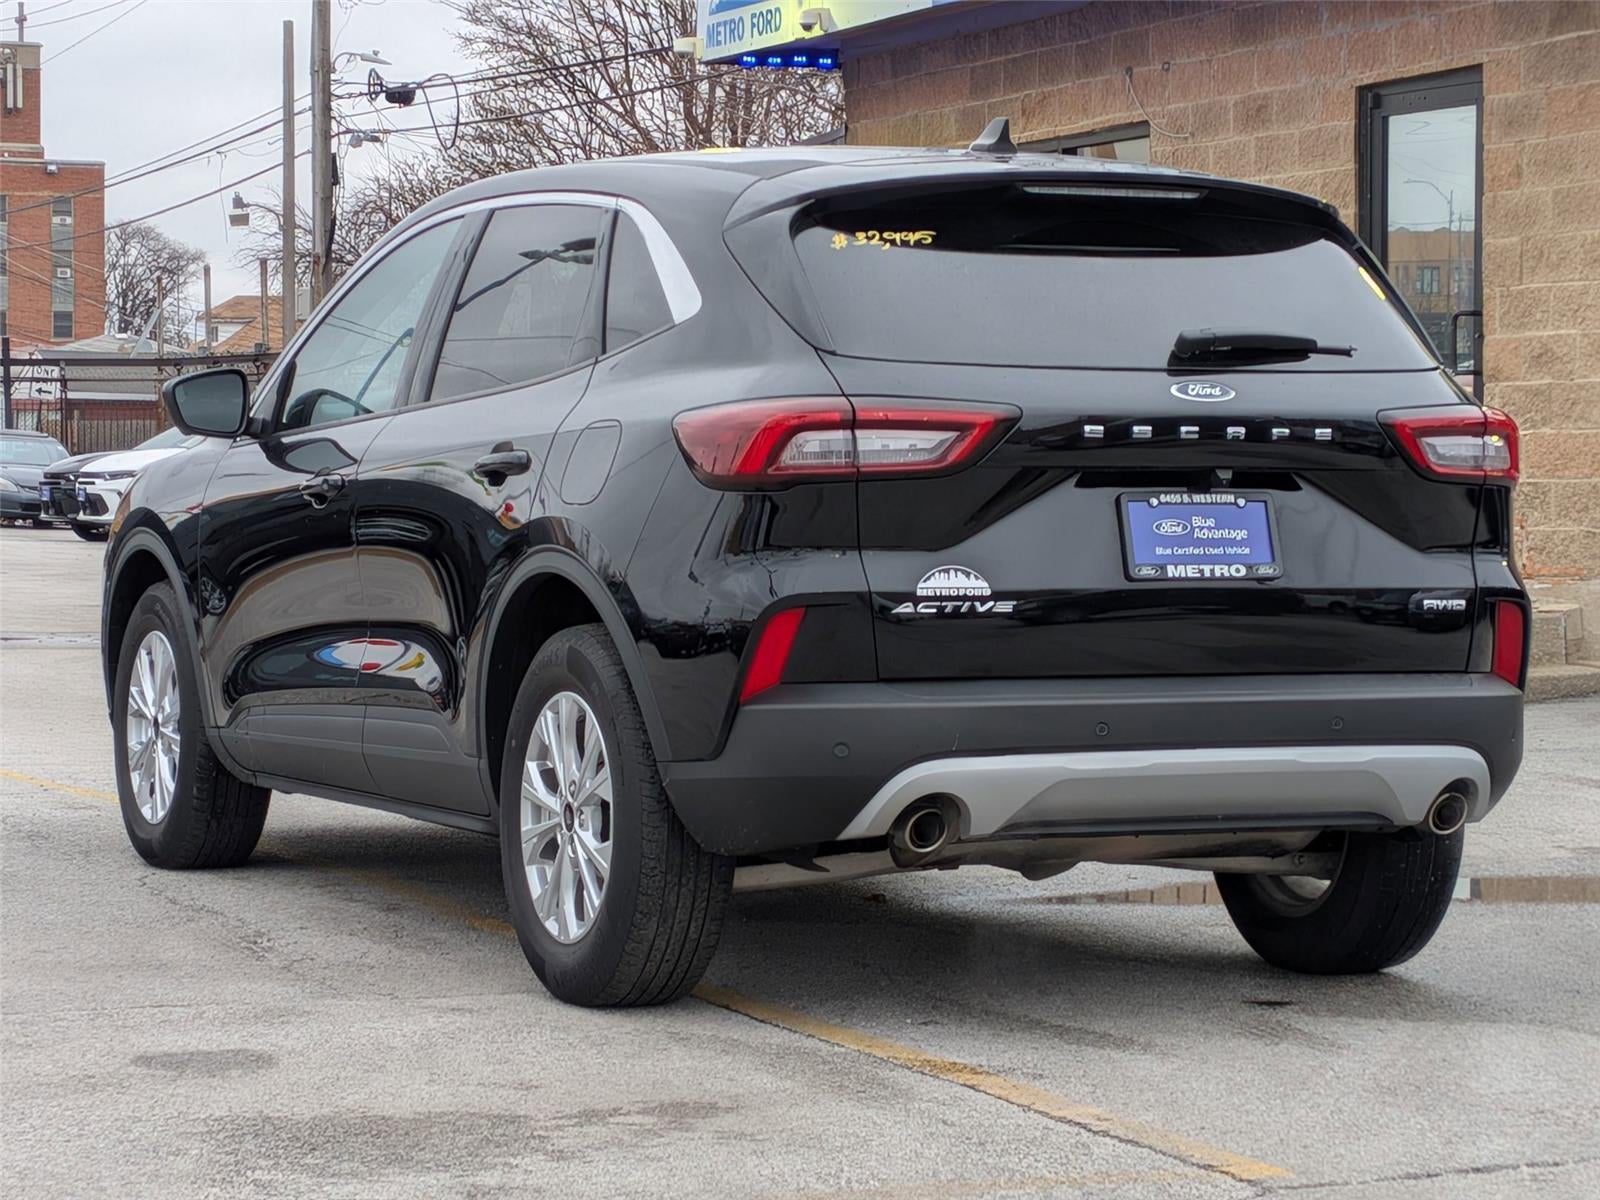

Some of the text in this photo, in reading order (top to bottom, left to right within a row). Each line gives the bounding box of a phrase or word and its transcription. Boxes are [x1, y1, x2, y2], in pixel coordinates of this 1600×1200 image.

[706, 7, 782, 48] METRO FORD
[1083, 424, 1333, 441] ESCAPE
[1192, 493, 1236, 504] WESTERN
[1192, 516, 1216, 527] Blue
[1193, 528, 1248, 540] Advantage
[1166, 564, 1247, 577] METRO
[891, 601, 1017, 613] ACTIVE
[1423, 599, 1466, 611] AWD
